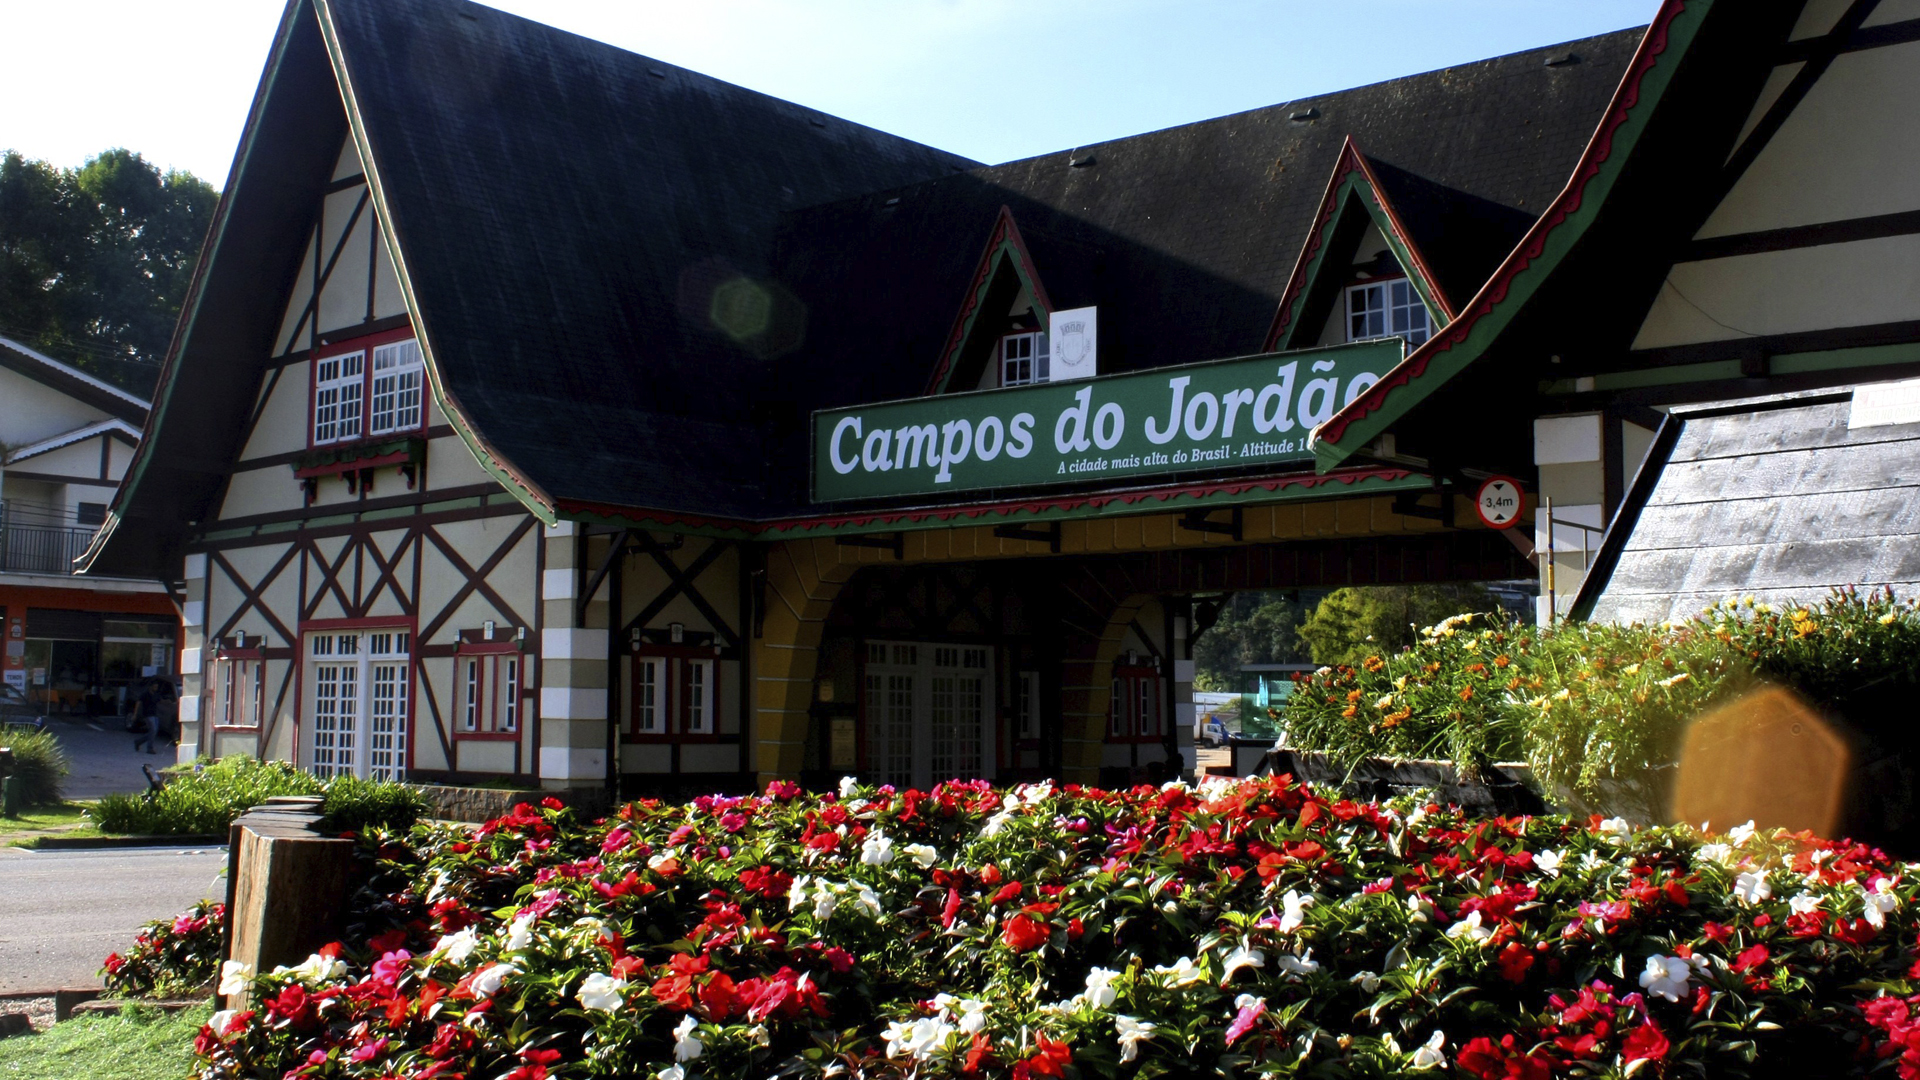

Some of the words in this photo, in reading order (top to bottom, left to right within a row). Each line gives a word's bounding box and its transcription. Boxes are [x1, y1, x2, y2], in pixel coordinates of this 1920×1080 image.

[829, 412, 1036, 484] Campos
[1054, 385, 1125, 455] do
[1057, 461, 1066, 474] A
[1069, 457, 1108, 473] cidade
[1111, 454, 1140, 469] mais
[1143, 451, 1169, 466] alta
[1172, 449, 1188, 464] do
[1191, 445, 1230, 462] Brasil
[1240, 439, 1294, 457] Altitude
[1486, 496, 1513, 509] 3,4m
